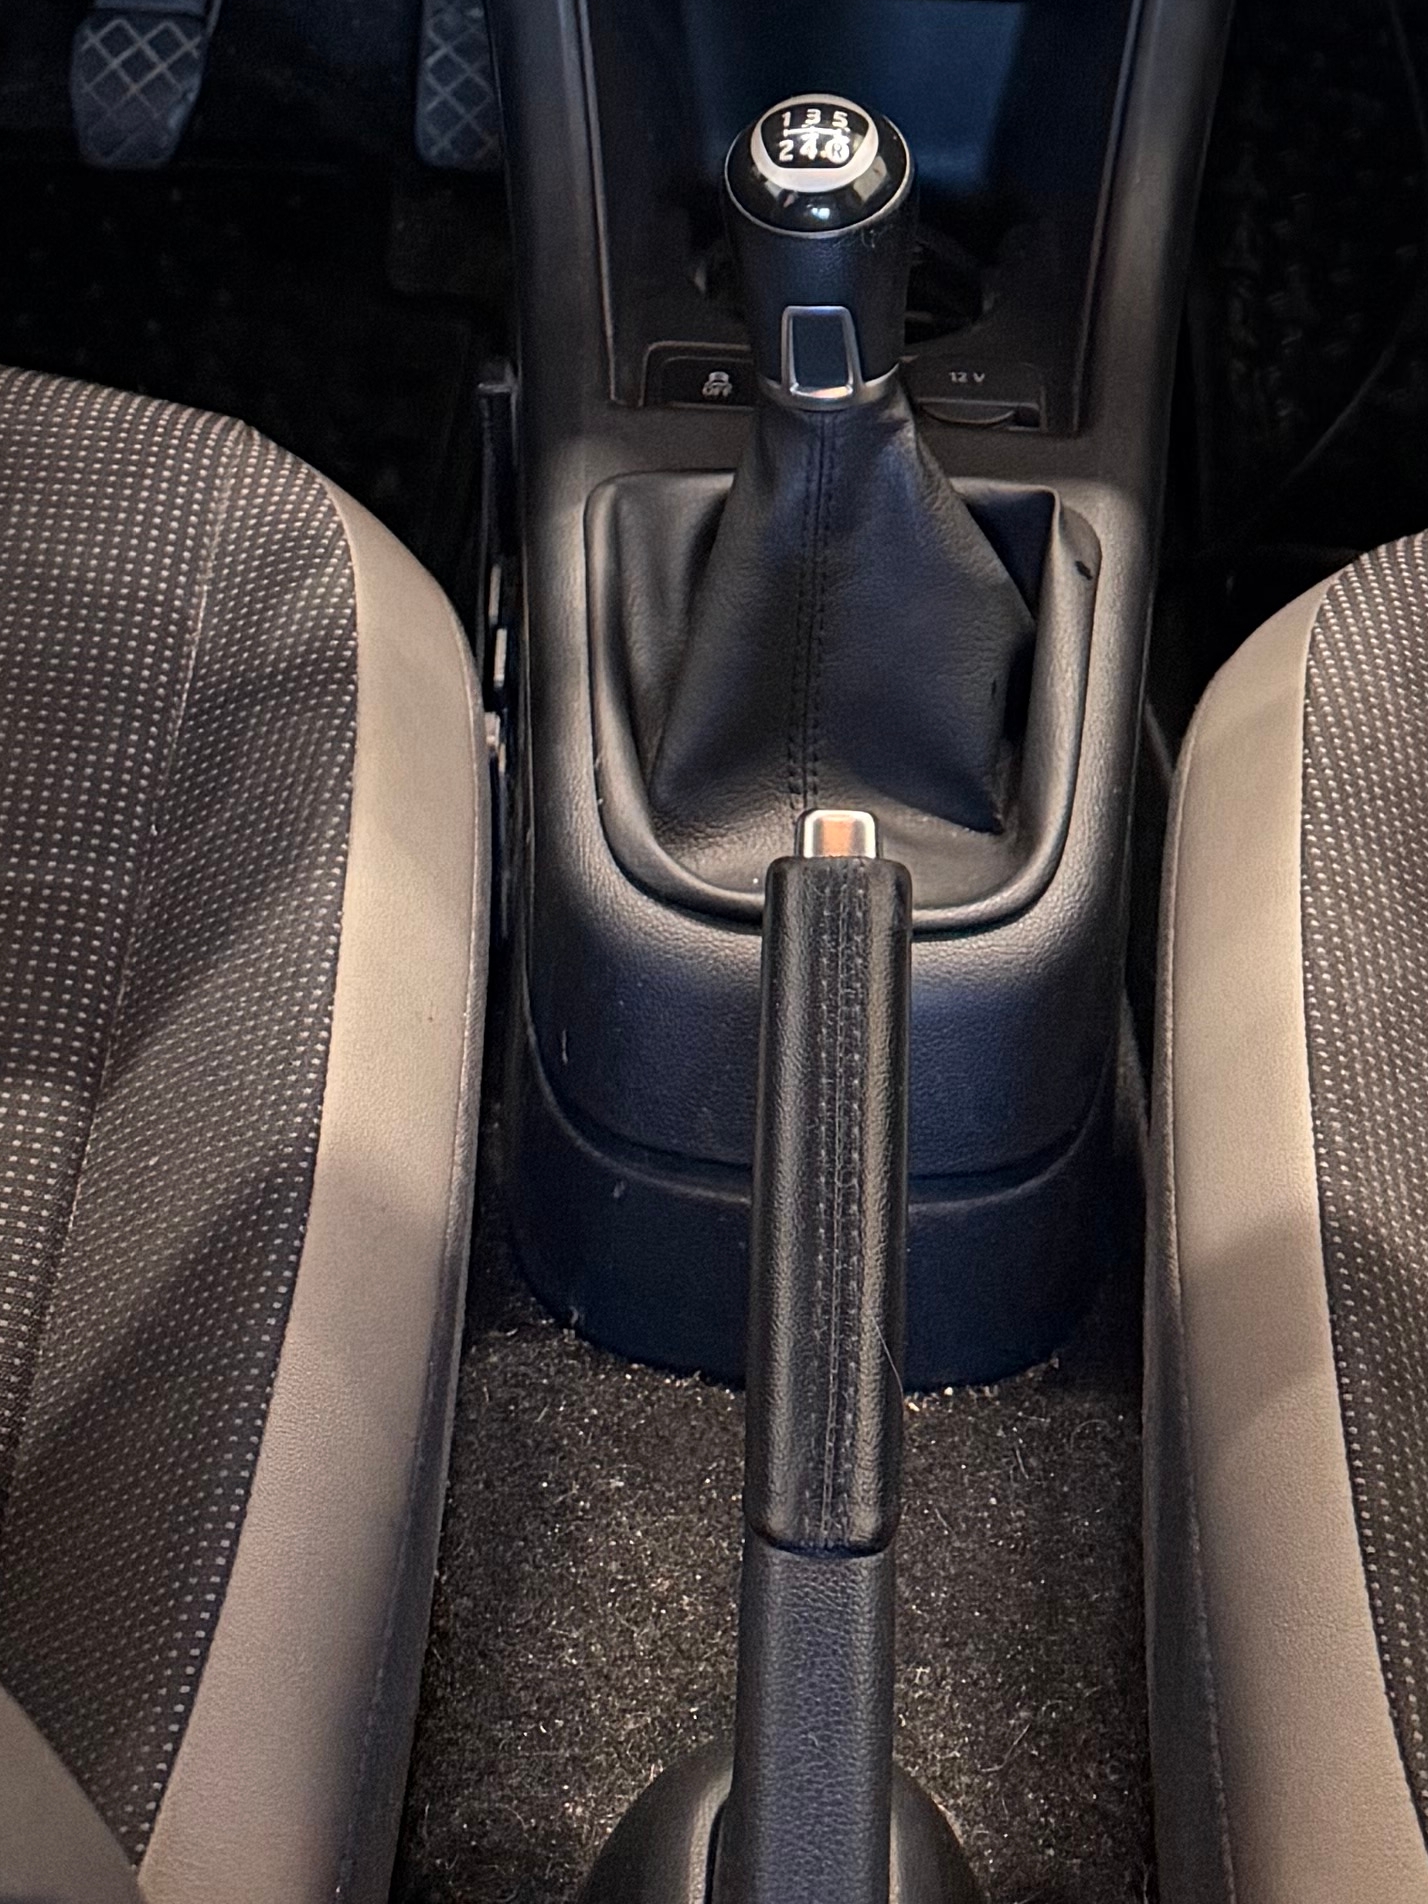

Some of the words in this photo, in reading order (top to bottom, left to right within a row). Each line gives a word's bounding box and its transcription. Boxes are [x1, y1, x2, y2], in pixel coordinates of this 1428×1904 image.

[782, 111, 792, 127] 1
[804, 108, 821, 125] 3
[831, 110, 849, 129] 5
[779, 139, 794, 162] 2
[949, 371, 967, 383] 12
